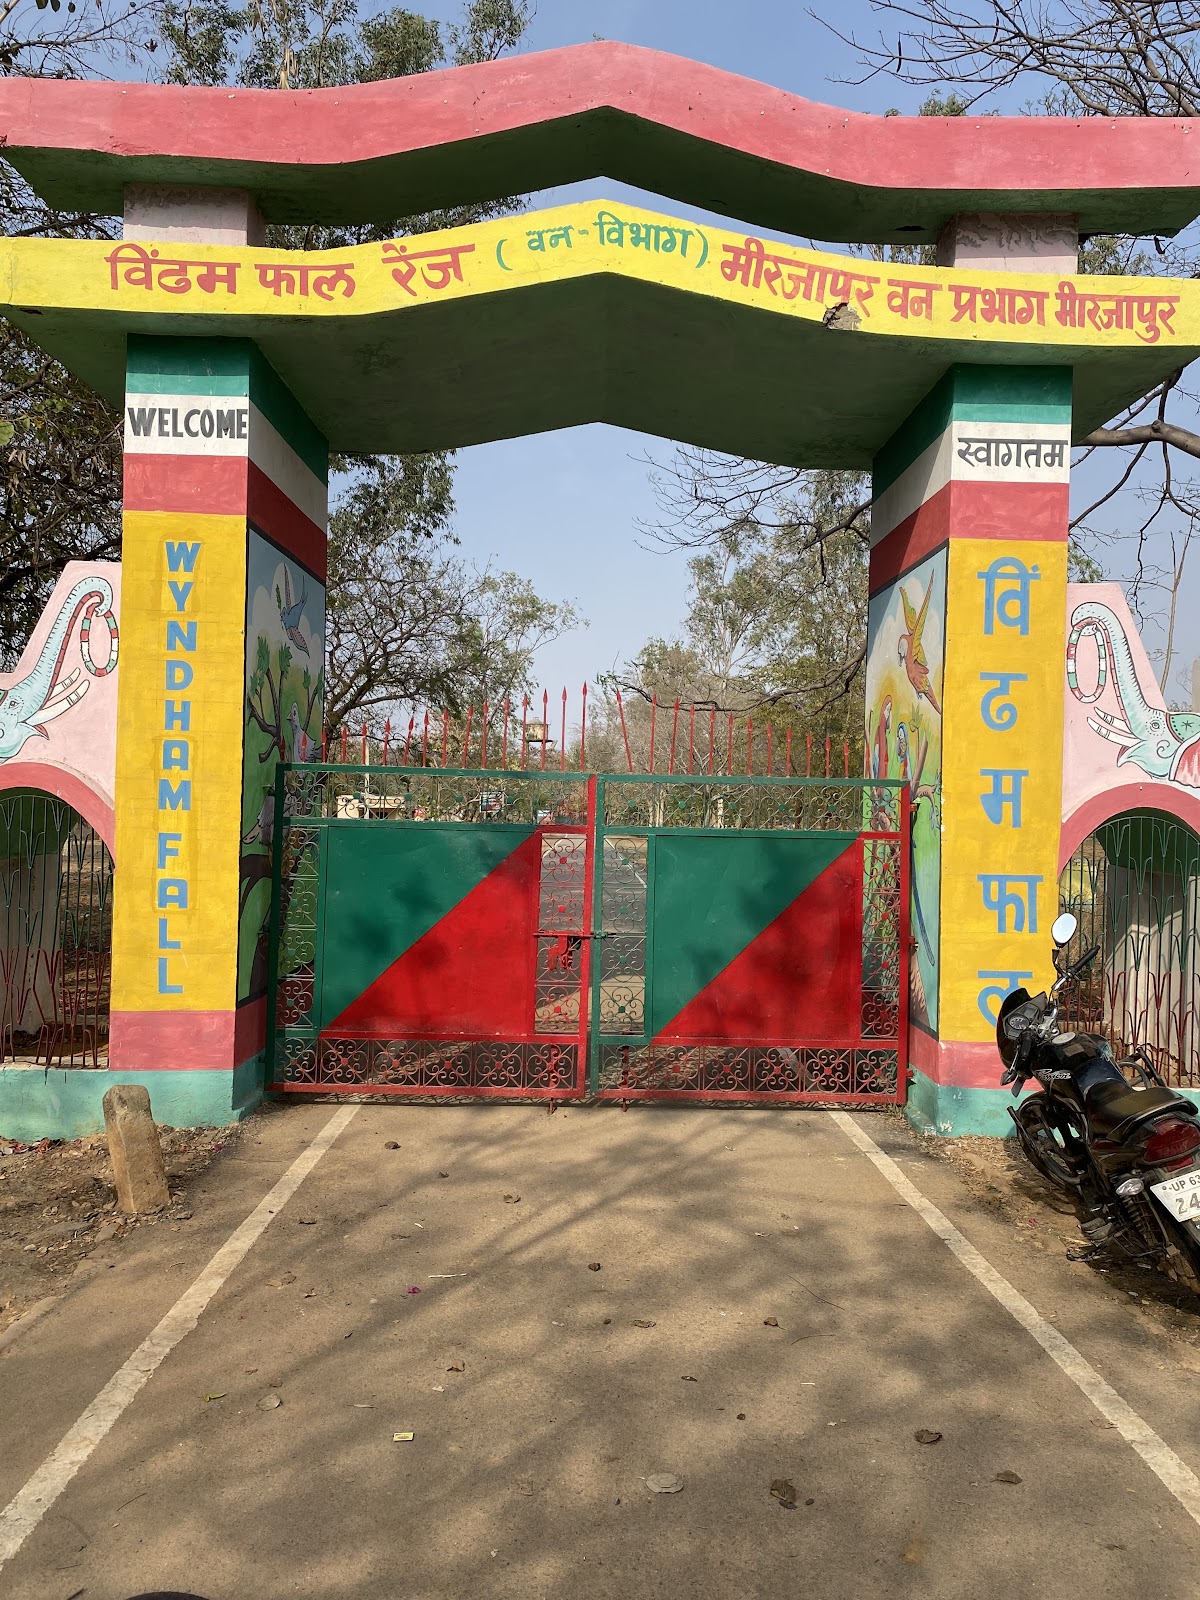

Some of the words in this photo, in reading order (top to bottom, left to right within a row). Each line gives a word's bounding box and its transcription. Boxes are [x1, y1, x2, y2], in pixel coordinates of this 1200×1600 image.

[104, 243, 241, 295] विंढम
[254, 263, 356, 301] फाल
[381, 243, 475, 297] रेंज
[721, 237, 880, 318] मीरजापर
[887, 279, 942, 321] वन
[948, 284, 1049, 327] प्रभाग
[1055, 281, 1180, 343] मीरजापुर
[127, 407, 248, 439] WELCOME
[958, 438, 1068, 468] स्वागतम
[158, 541, 201, 810] WYNDHAM
[158, 832, 188, 994] FALL
